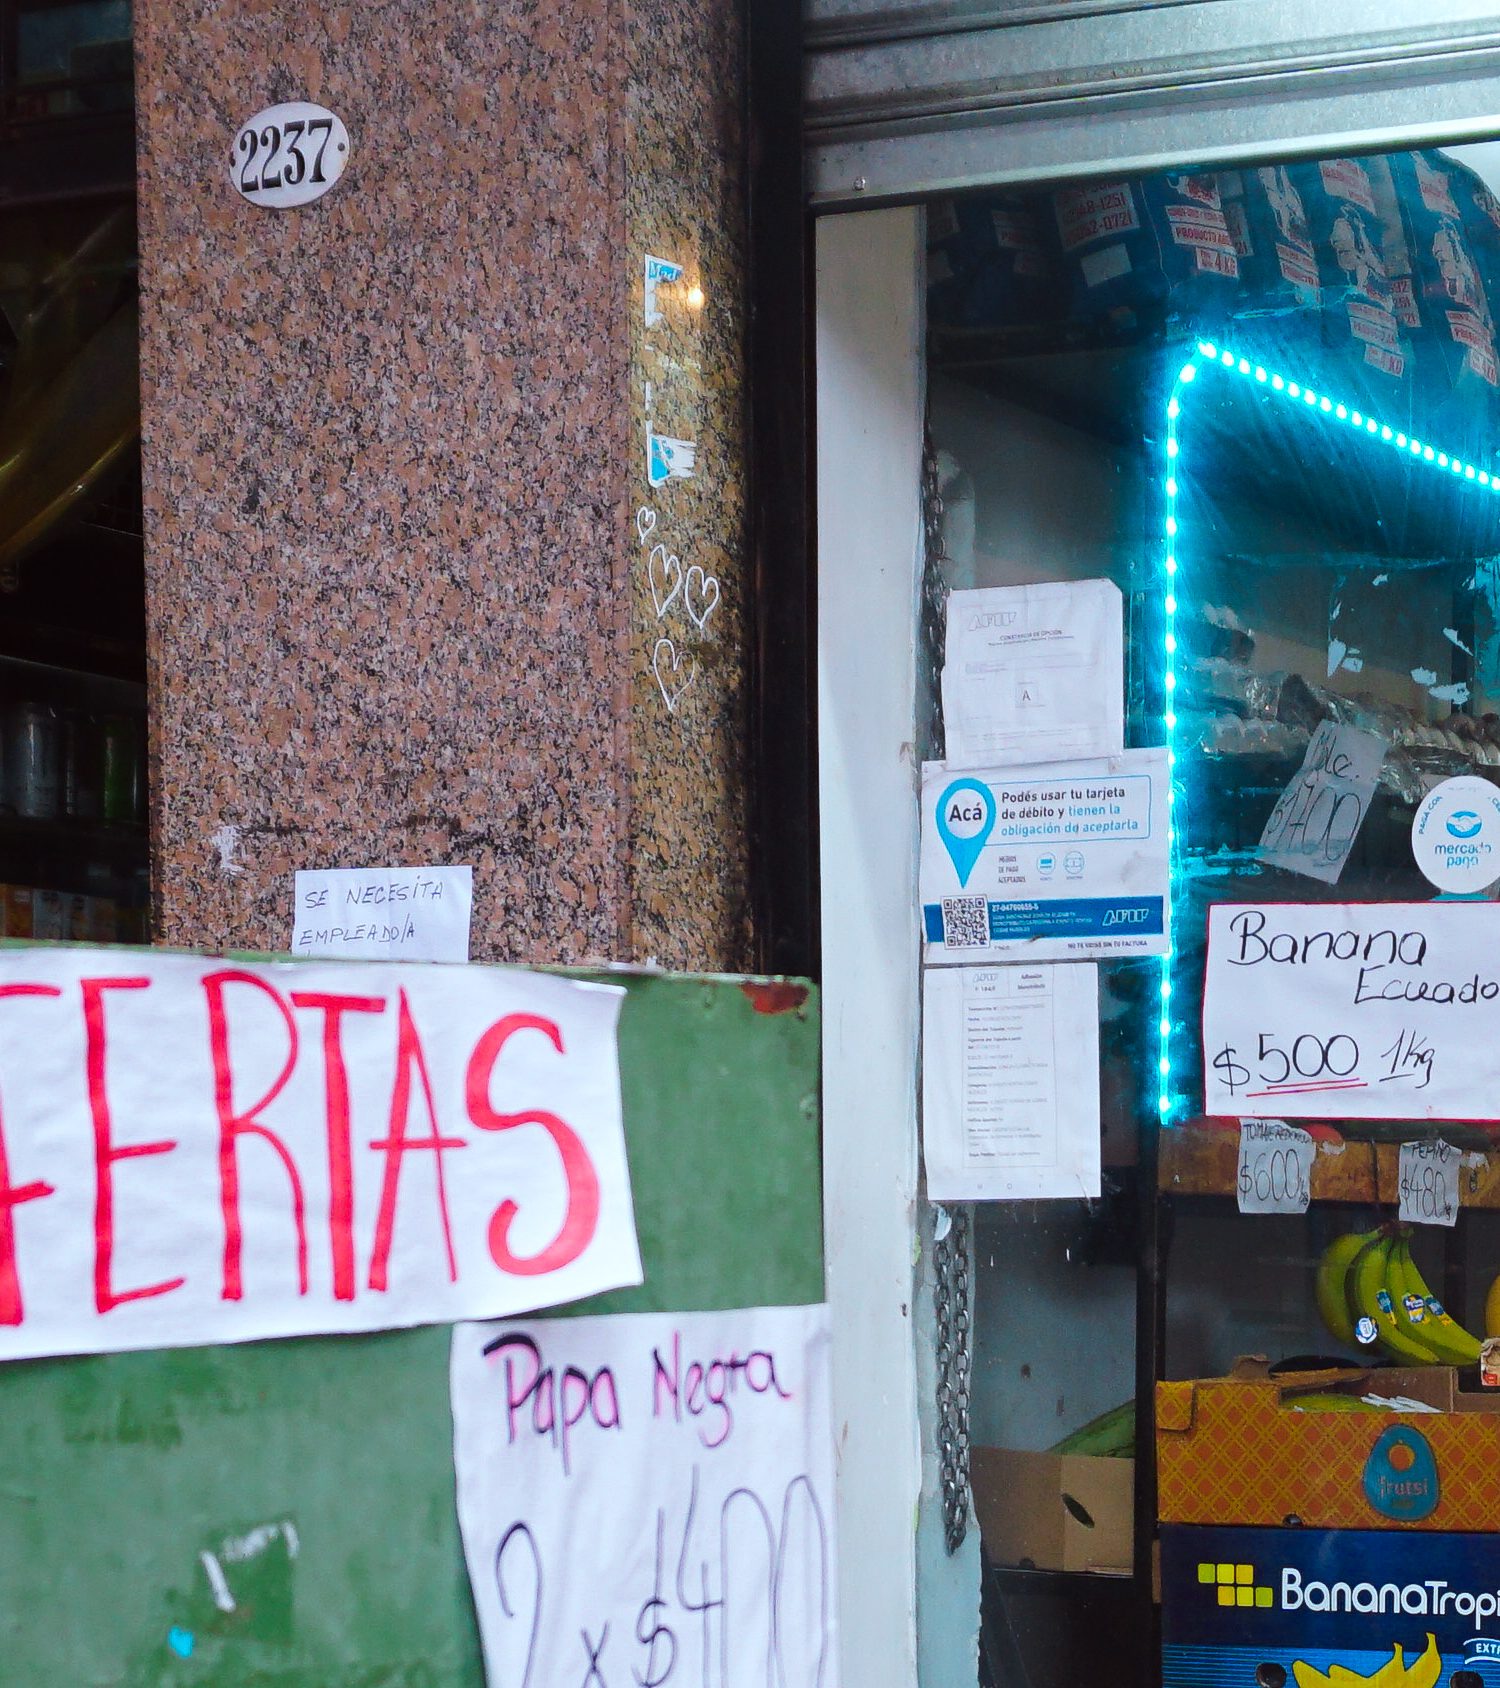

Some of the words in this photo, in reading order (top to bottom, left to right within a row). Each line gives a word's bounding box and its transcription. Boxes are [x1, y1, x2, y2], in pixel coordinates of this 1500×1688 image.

[239, 118, 333, 193] 2237
[1001, 790, 1038, 804] Podés
[1041, 790, 1067, 802] usar
[1070, 788, 1083, 800] tu
[1086, 786, 1126, 801] tarjeta
[949, 802, 983, 822] Acá
[1001, 808, 1016, 820] de
[1018, 805, 1055, 819] débito
[1068, 803, 1106, 817] tienen
[1109, 803, 1122, 815] la
[1001, 822, 1061, 838] obligación
[1064, 821, 1080, 834] de
[1082, 819, 1140, 834] aceptarla
[304, 889, 330, 909] SE
[299, 913, 415, 946] EMPLEADO/A
[1229, 910, 1427, 968] Banana
[481, 1333, 621, 1476] Papa
